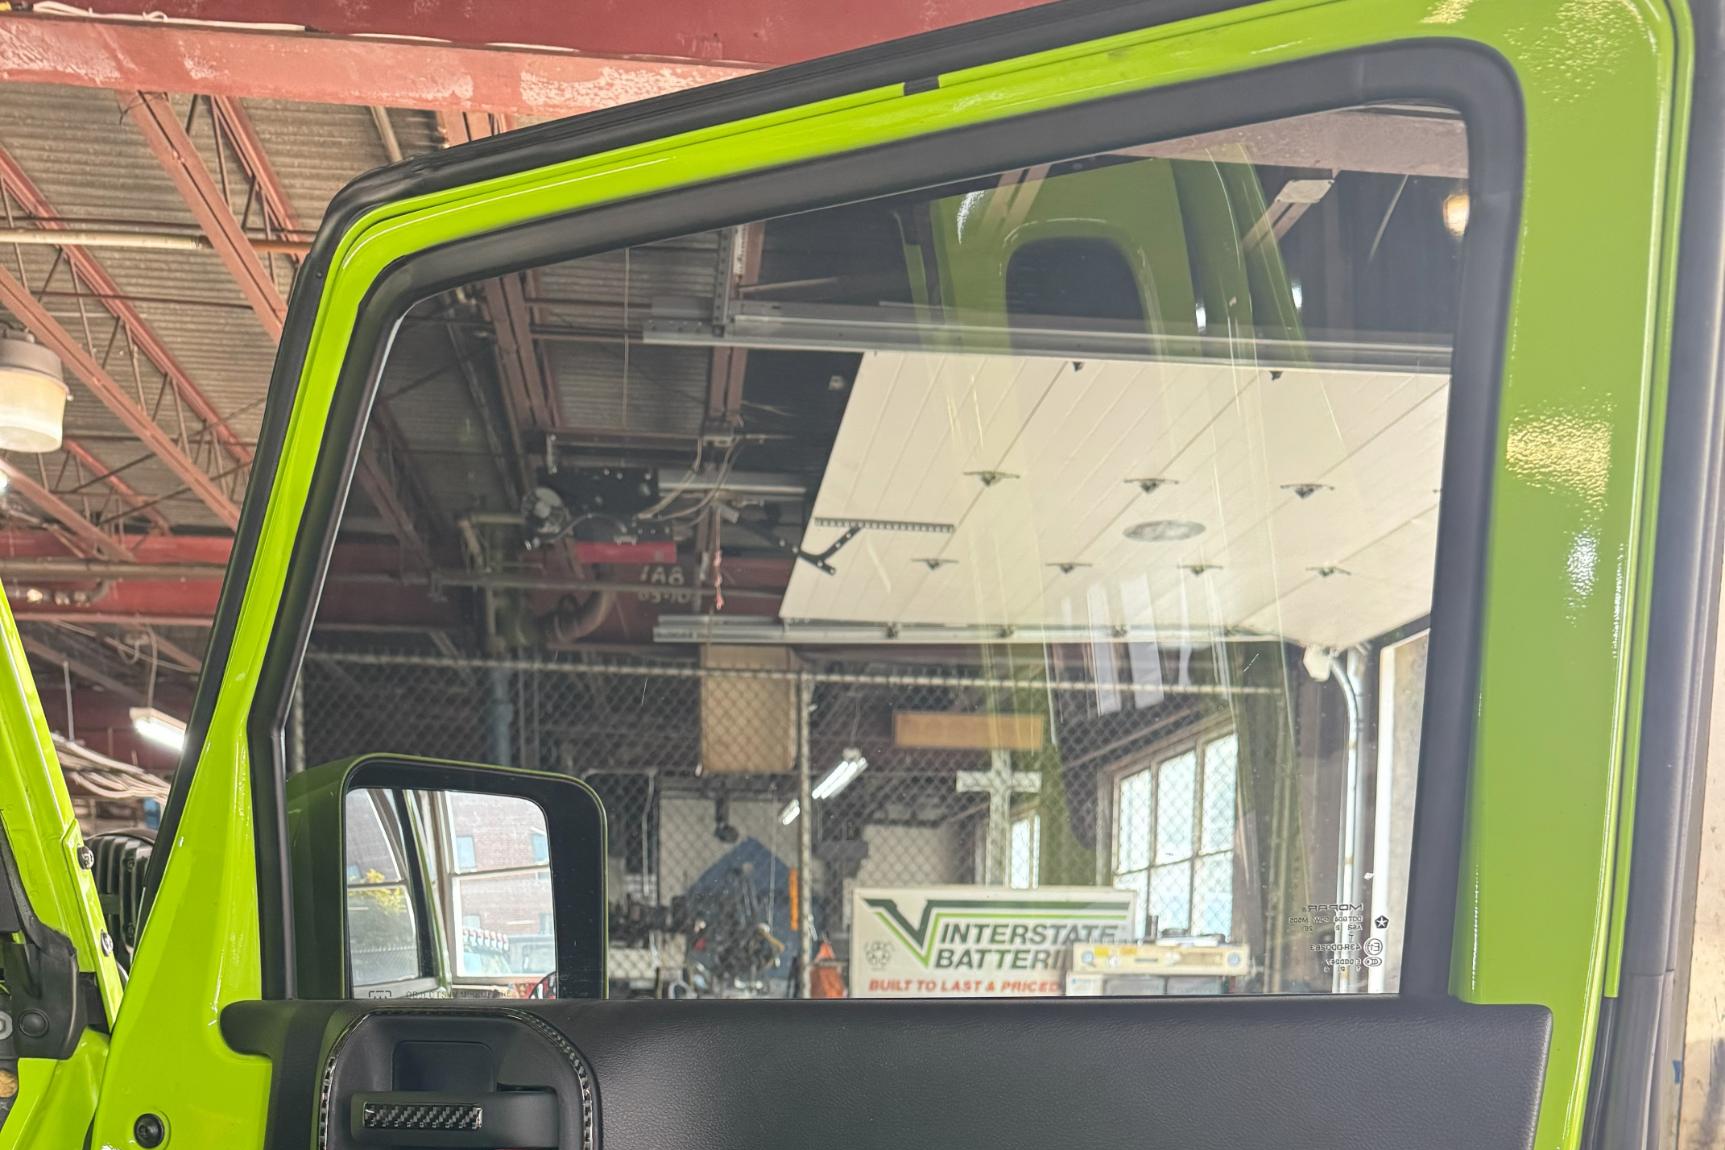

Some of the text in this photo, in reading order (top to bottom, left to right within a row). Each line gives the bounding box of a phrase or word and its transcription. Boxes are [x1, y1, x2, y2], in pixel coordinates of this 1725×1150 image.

[940, 922, 1118, 945] INTERSTATE
[934, 947, 1065, 970] BATTERI
[867, 978, 912, 992] BUILT
[916, 978, 937, 992] TO
[941, 979, 982, 993] LAST
[987, 979, 996, 993] &
